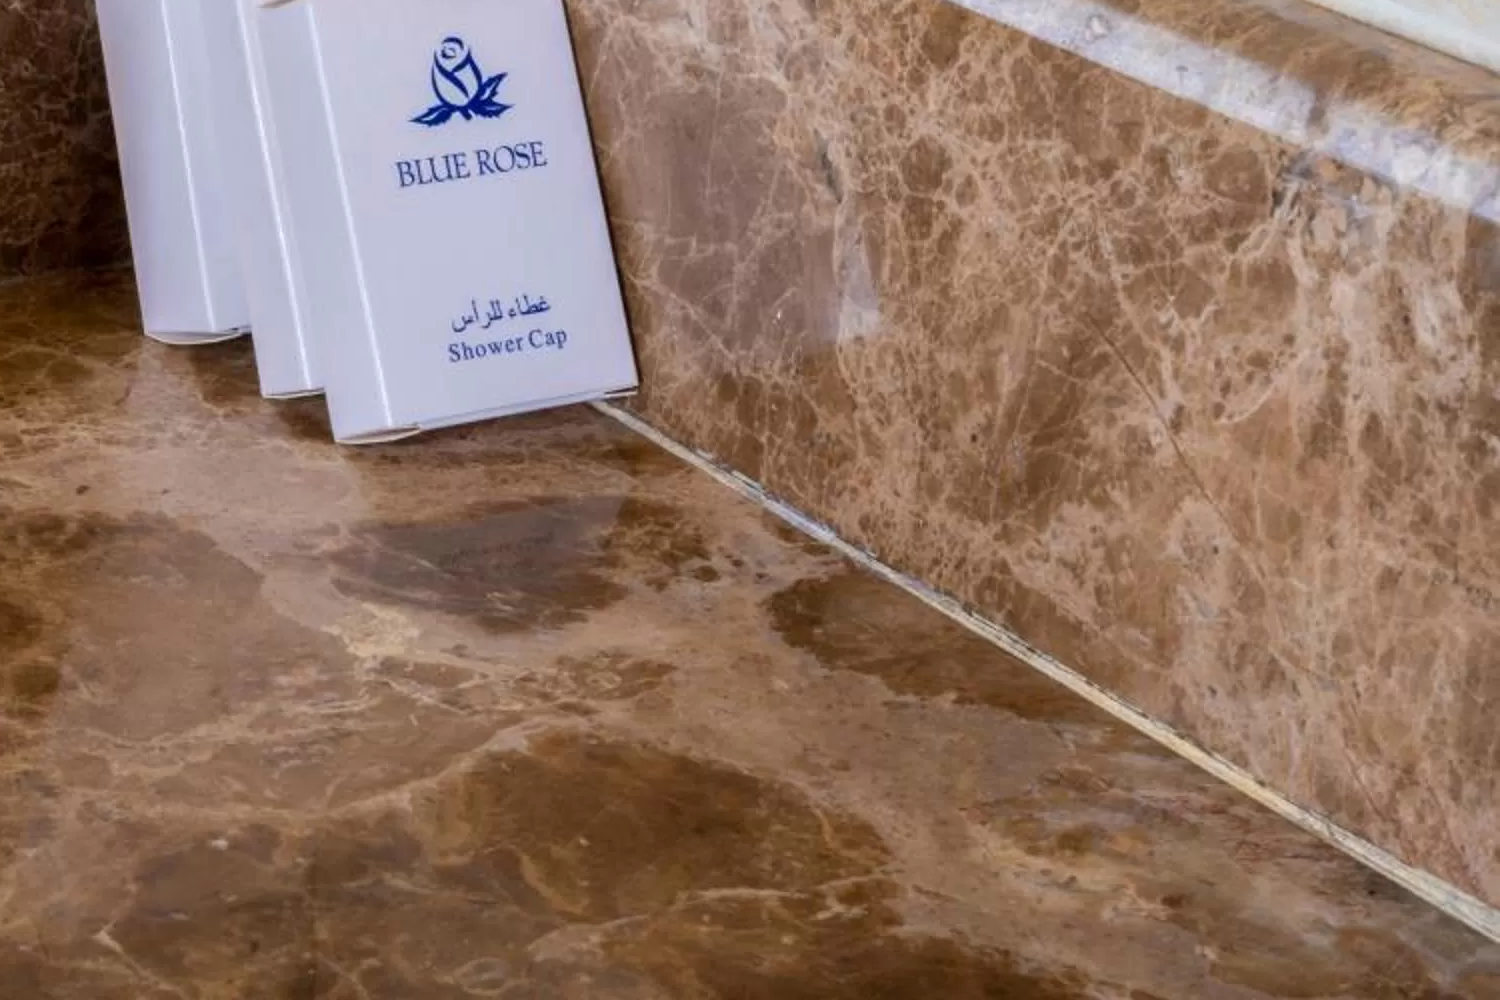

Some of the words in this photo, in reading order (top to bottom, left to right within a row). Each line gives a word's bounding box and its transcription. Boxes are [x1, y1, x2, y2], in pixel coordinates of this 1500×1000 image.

[396, 152, 471, 188] BLUE
[475, 141, 548, 176] ROSE
[508, 294, 552, 319] غطاء
[448, 335, 524, 363] Shower
[528, 328, 568, 350] Cap
